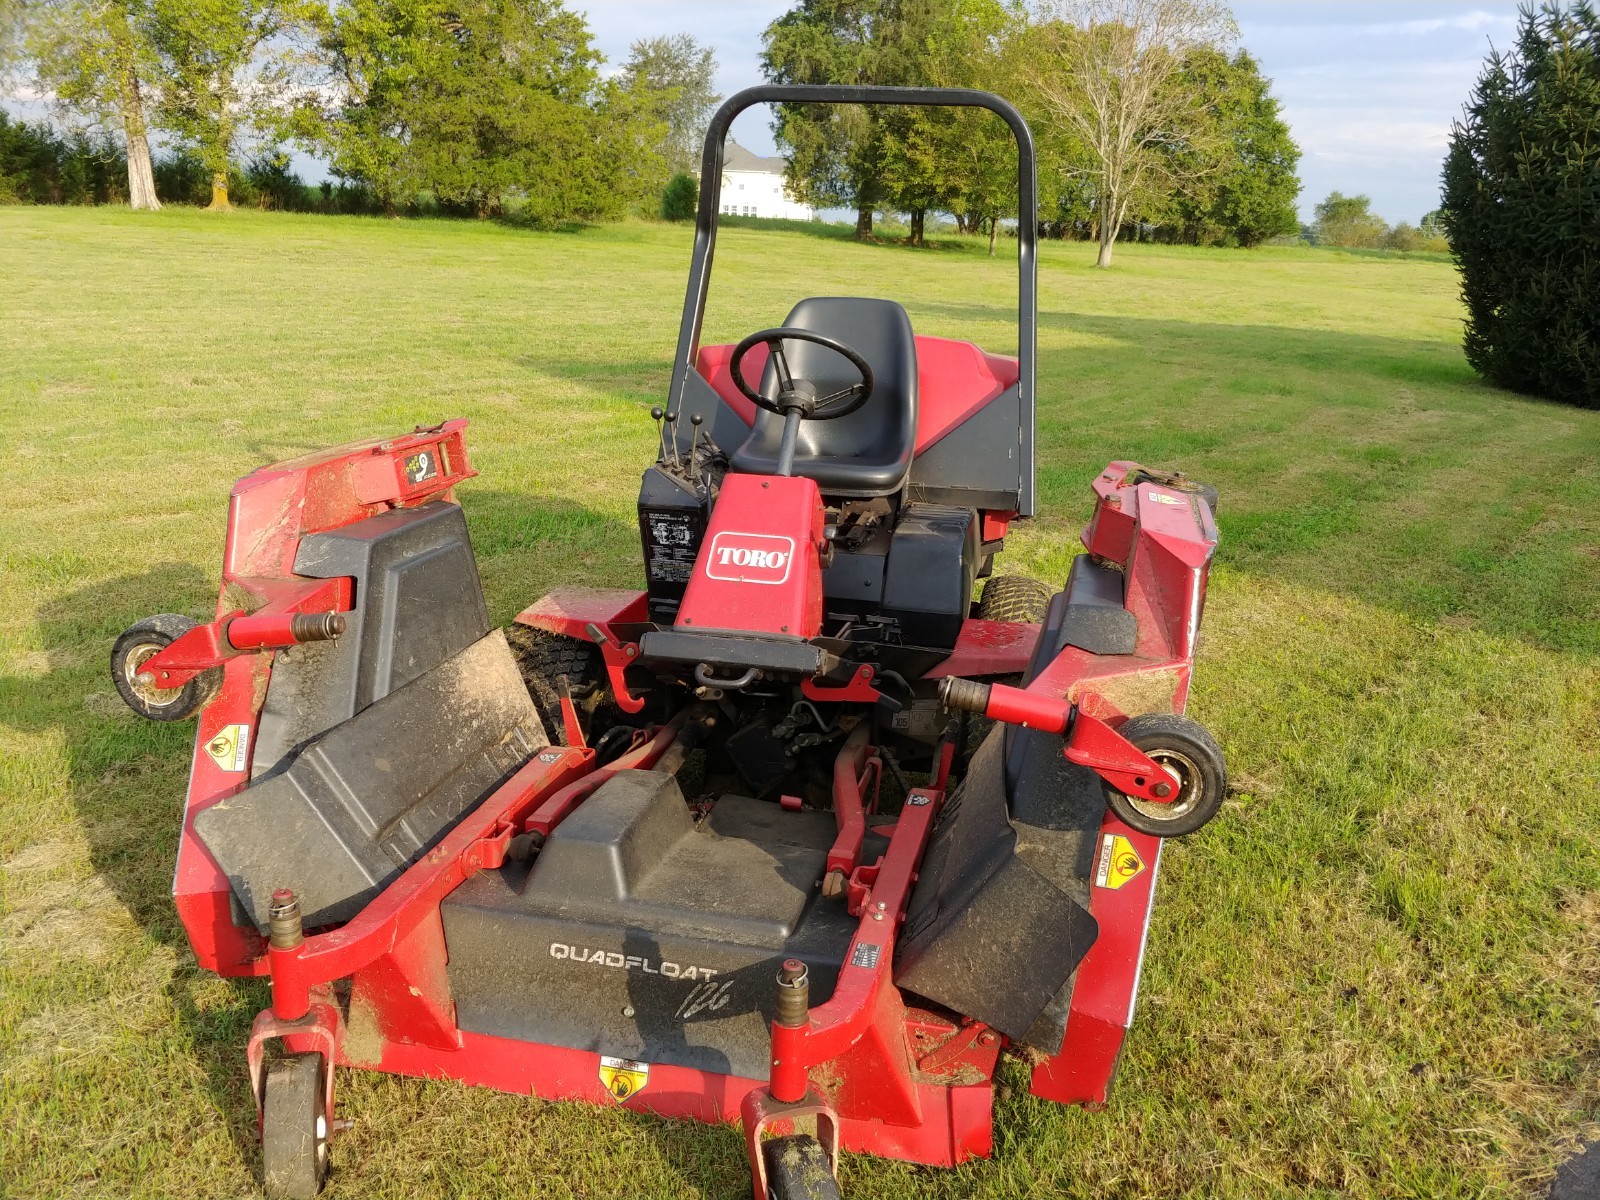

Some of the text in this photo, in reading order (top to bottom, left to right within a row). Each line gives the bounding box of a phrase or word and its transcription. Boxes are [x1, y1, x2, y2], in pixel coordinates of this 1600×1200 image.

[717, 547, 785, 569] TORO
[237, 733, 246, 762] DANGER
[1100, 844, 1111, 876] DANGER
[550, 943, 718, 983] QUADFLOAT
[674, 980, 736, 1019] 126
[610, 1060, 639, 1070] DANGER
